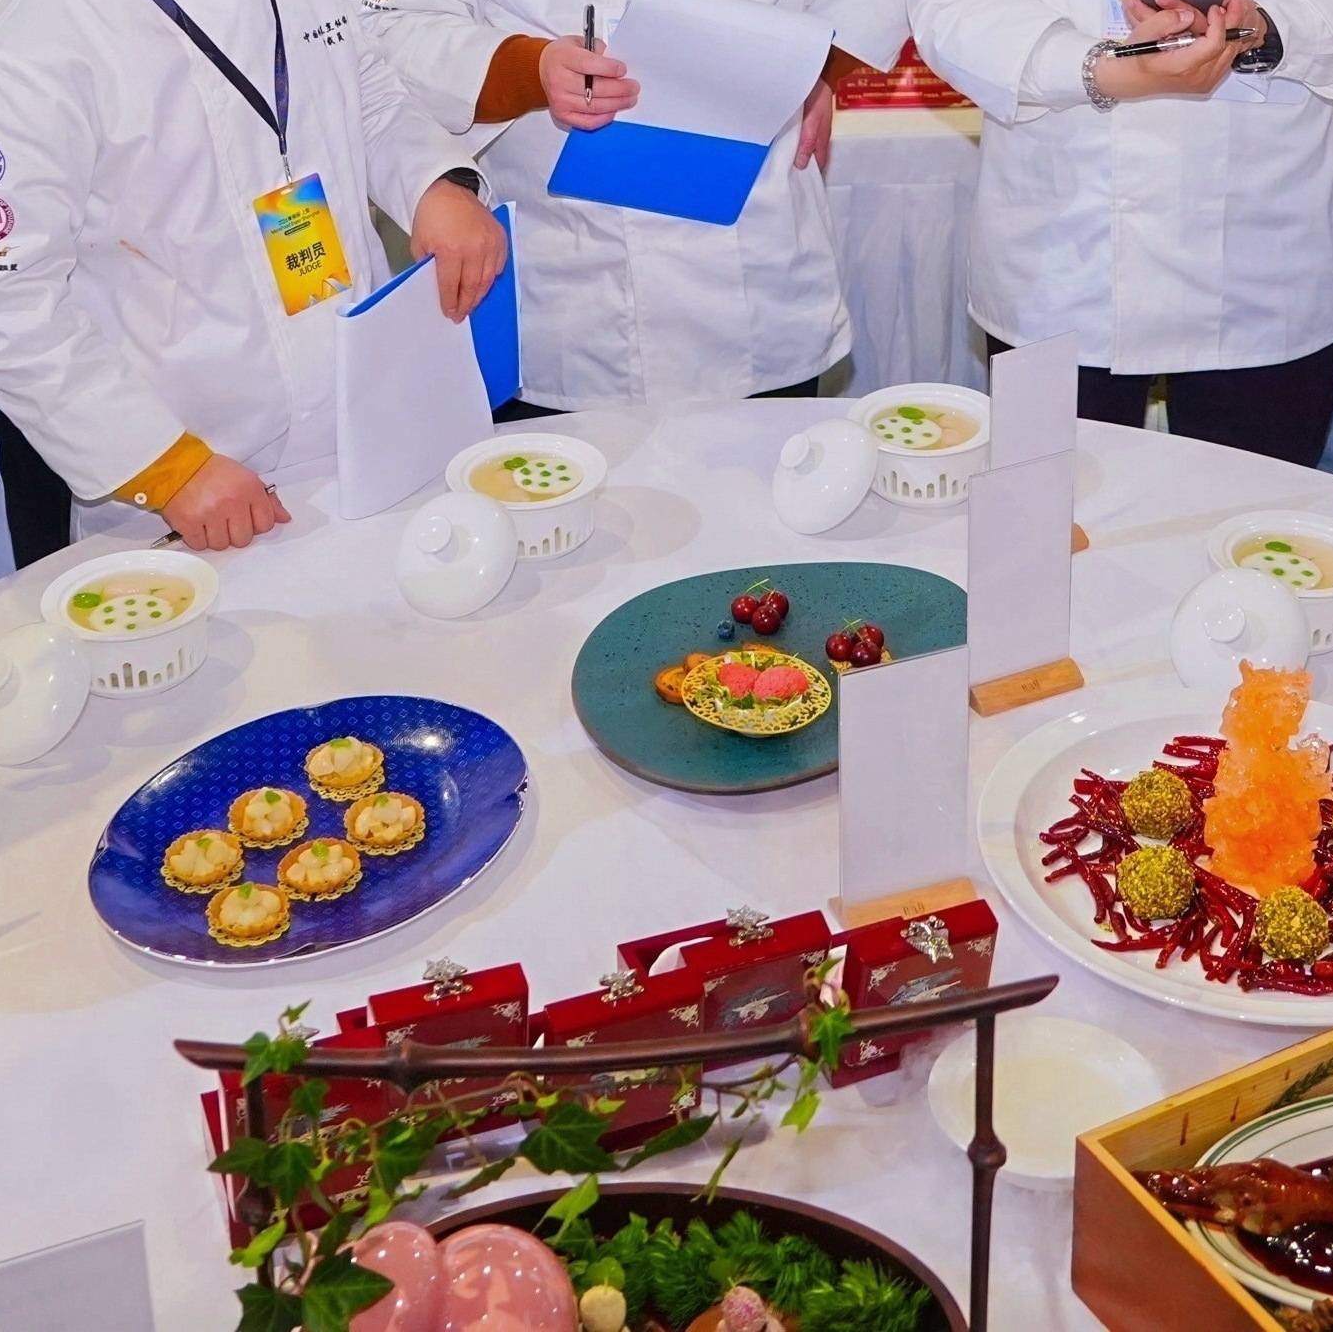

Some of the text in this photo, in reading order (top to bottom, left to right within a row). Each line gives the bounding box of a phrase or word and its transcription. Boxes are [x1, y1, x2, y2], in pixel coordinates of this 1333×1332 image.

[285, 241, 327, 271] 裁判员
[299, 260, 323, 277] JUDGE
